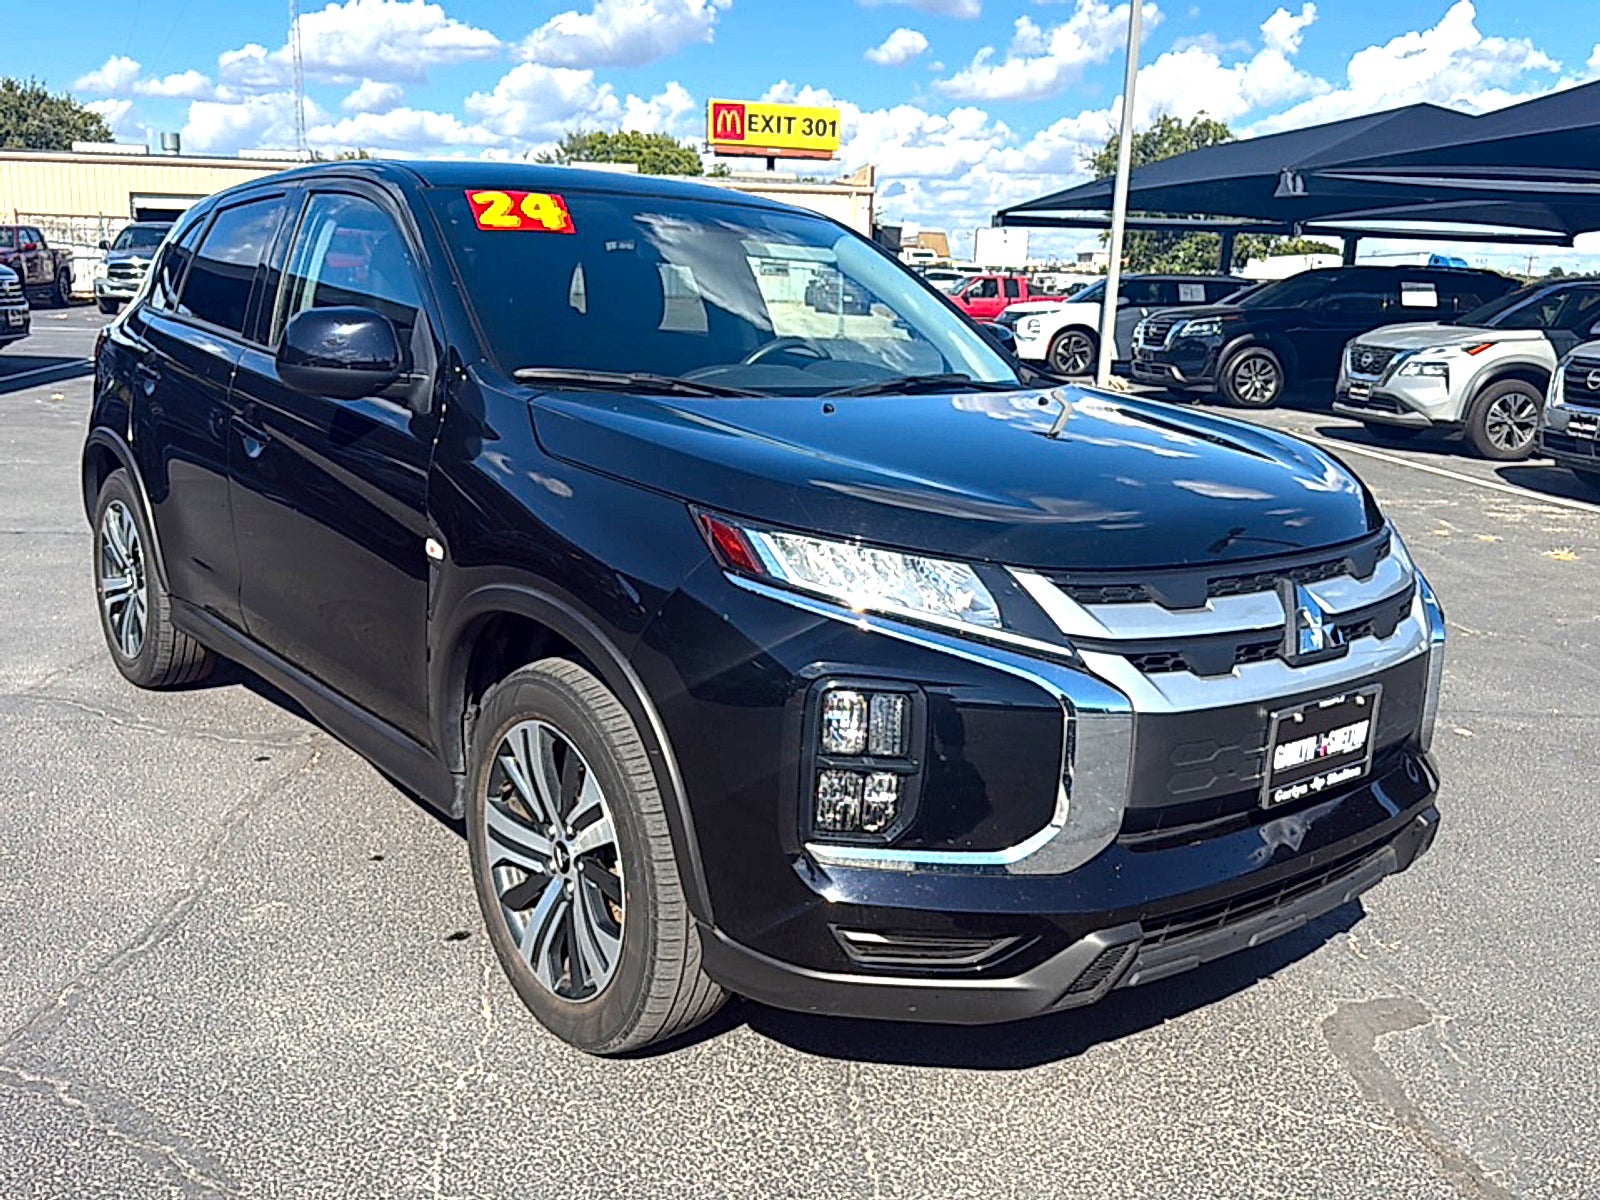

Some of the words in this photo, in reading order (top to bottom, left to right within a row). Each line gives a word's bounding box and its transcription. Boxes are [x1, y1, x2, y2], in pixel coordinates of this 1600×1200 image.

[748, 114, 797, 134] EXIT
[801, 118, 837, 137] 301
[472, 191, 567, 230] 24
